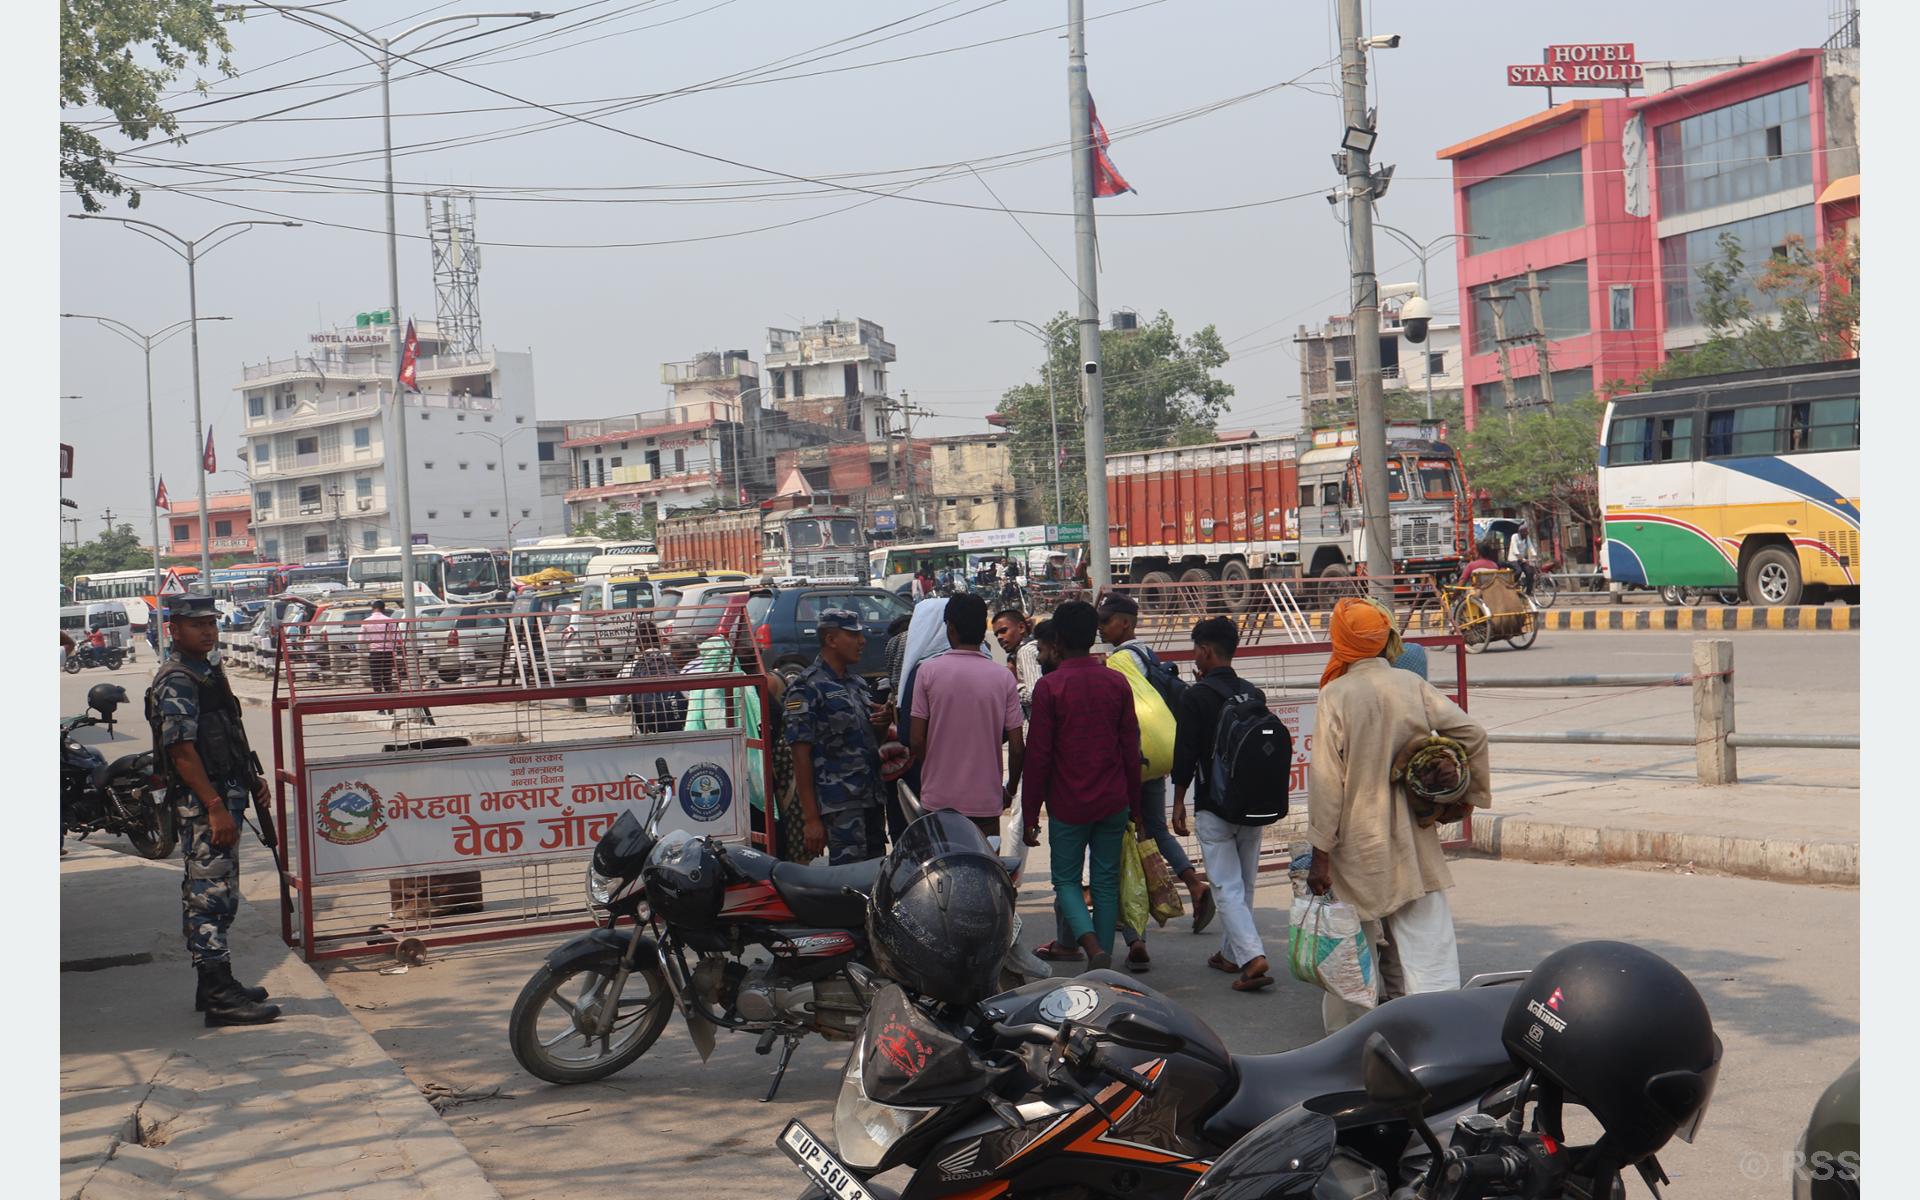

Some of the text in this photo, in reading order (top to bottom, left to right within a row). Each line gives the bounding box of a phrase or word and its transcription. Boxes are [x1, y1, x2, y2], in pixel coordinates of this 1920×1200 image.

[1554, 45, 1631, 62] HOTEL
[1511, 64, 1643, 82] STAR HOLID
[311, 334, 384, 343] HOTEL AAKASH
[607, 546, 653, 556] TOURIST
[509, 753, 563, 764] नेपाल सरकार
[388, 792, 472, 820] भैरहवा
[480, 786, 564, 812] भन्सार
[451, 814, 526, 856] चेक
[799, 1138, 820, 1161] UP
[820, 1160, 849, 1192] 56U
[942, 1169, 993, 1182] HONDA
